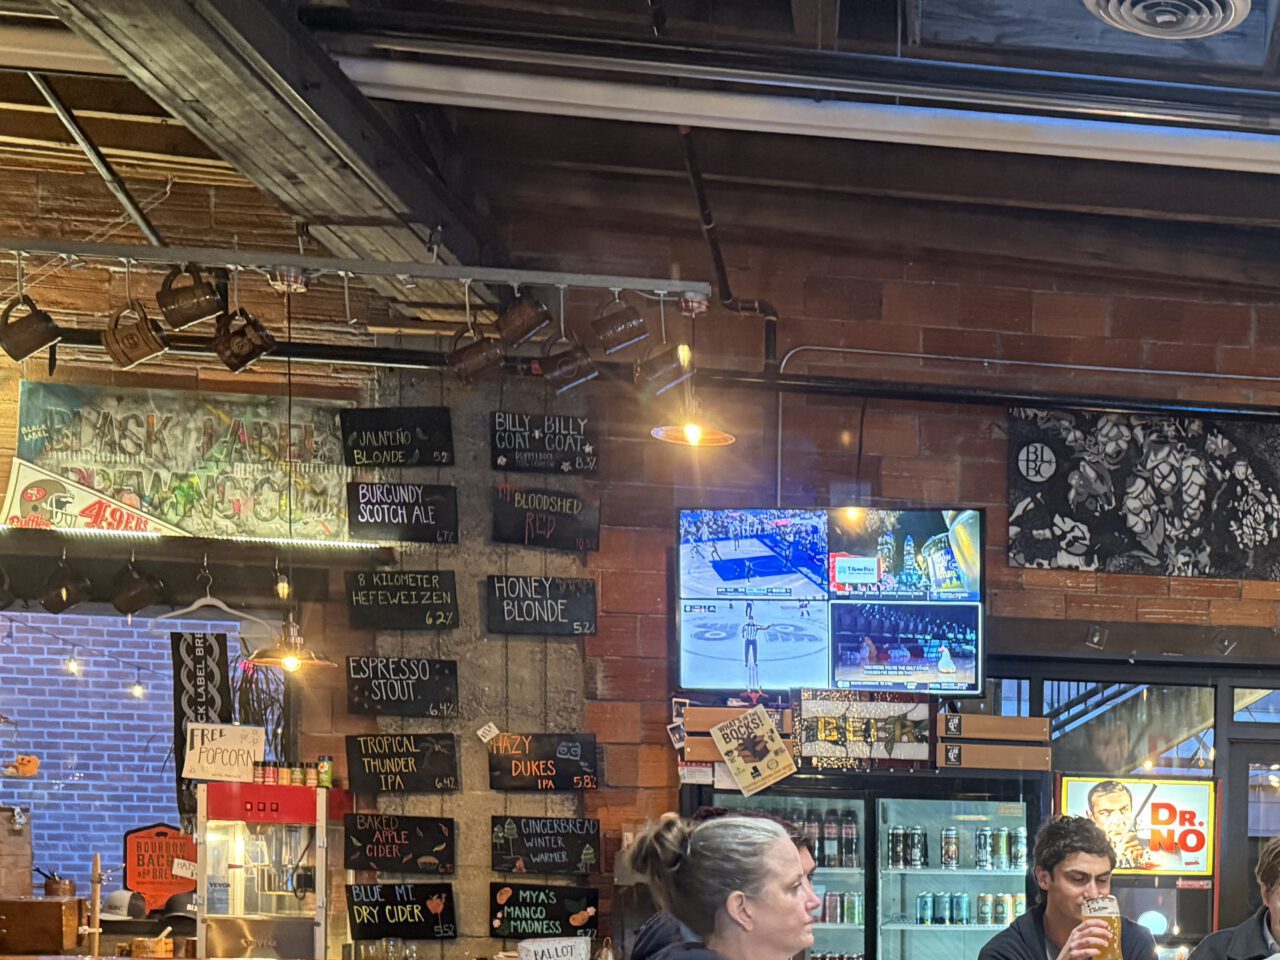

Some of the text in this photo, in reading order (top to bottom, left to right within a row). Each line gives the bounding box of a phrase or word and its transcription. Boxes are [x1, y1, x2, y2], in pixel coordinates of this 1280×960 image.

[21, 424, 48, 435] BLACK
[495, 412, 588, 435] BILLY BILLY
[23, 430, 49, 441] LABEL
[495, 431, 584, 451] GOAT GOAT
[354, 449, 405, 465] BLONDE
[359, 484, 423, 503] BURGUNDY
[514, 492, 582, 514] BLOODSHED
[79, 499, 149, 532] 49ERS
[358, 504, 407, 524] SCOTCH
[412, 505, 435, 524] ALE
[525, 511, 556, 545] RED
[357, 573, 439, 589] 8 KILOMETER
[494, 576, 552, 598] HONEY
[352, 590, 451, 606] HEFEWEIZEN
[503, 599, 569, 622] BLONDE
[349, 657, 430, 681] ESPRESSO
[196, 661, 206, 702] LABEL
[371, 679, 416, 701] STOUT
[717, 717, 742, 734] WHAT'S
[721, 714, 765, 745] BOCKS!
[189, 728, 227, 751] FREE
[357, 735, 421, 754] TROPICAL
[492, 735, 532, 755] HAZY
[198, 747, 257, 767] POPCORN
[362, 757, 417, 773] THUNDER
[511, 760, 557, 776] DUKES
[379, 774, 404, 790] IPA
[537, 779, 555, 789] IPA
[356, 815, 399, 831] BAKED
[521, 818, 598, 834] GINGERBREAD
[373, 831, 409, 844] APPLE
[524, 836, 565, 848] WINTER
[1149, 828, 1206, 853] NO
[136, 841, 186, 854] BOURBON
[365, 844, 401, 858] CIDER
[530, 852, 568, 863] WARMER
[351, 885, 385, 901] BLUE
[519, 889, 557, 904] MYA'S
[353, 904, 425, 924] DRY CIDER
[504, 906, 546, 919] MANGO
[510, 920, 562, 934] MADNESS
[534, 945, 575, 960] BALLOT
